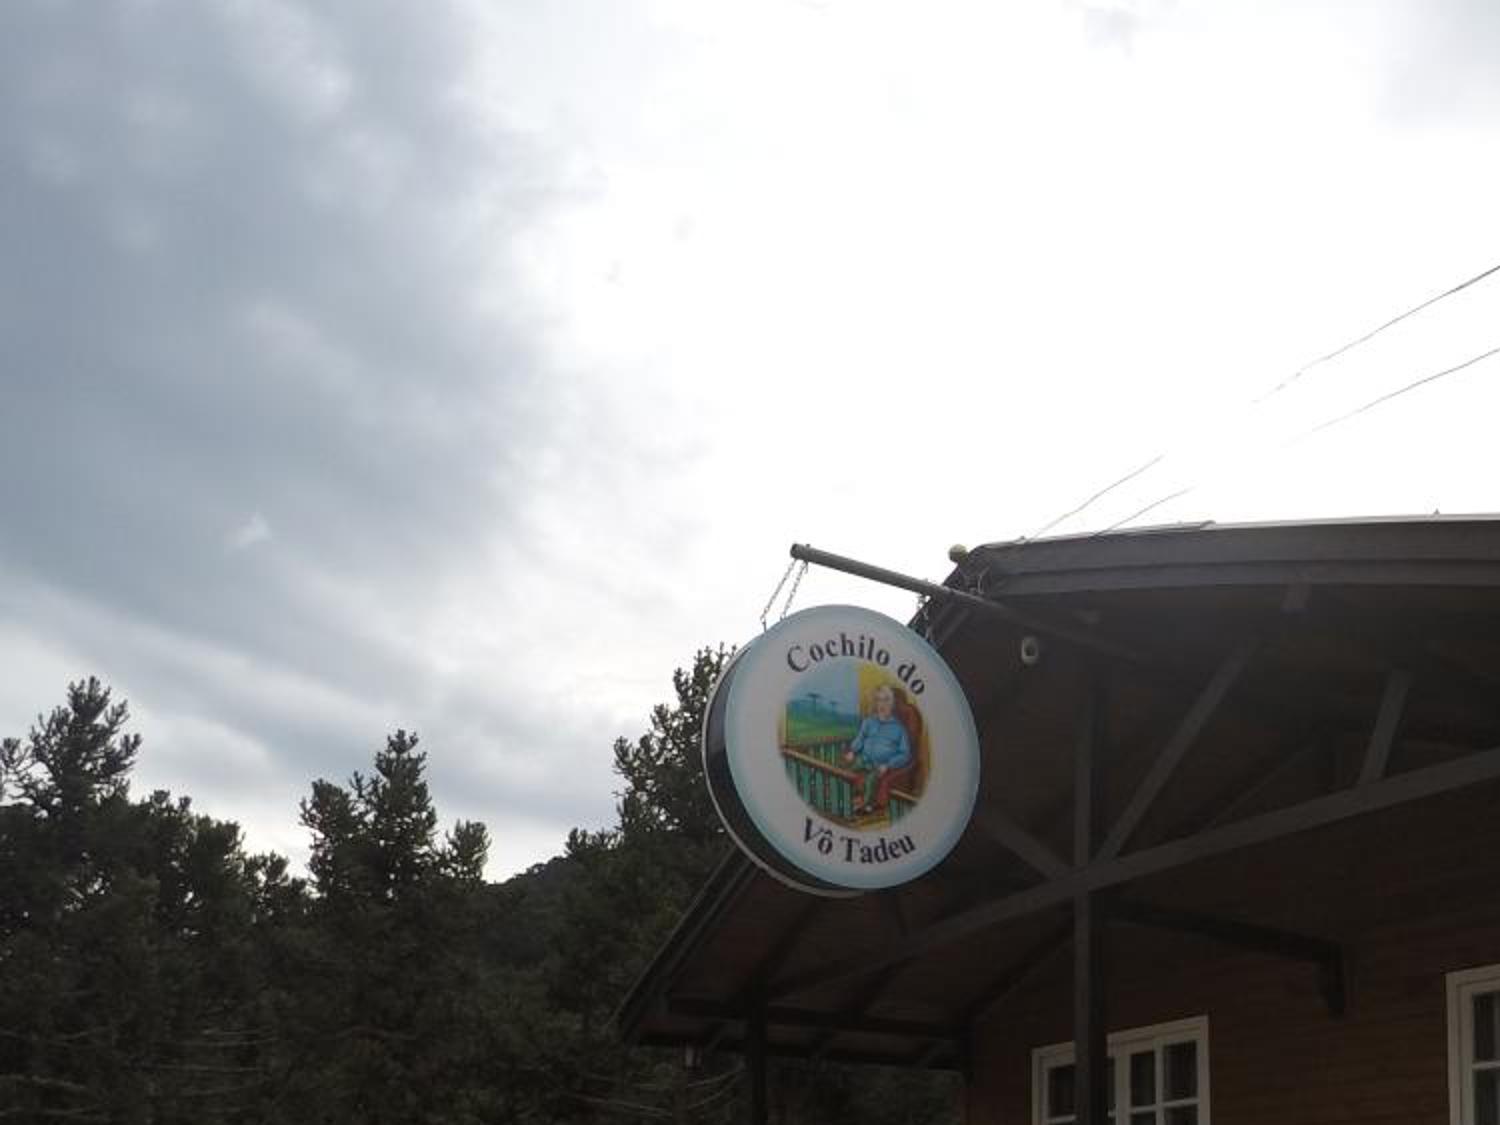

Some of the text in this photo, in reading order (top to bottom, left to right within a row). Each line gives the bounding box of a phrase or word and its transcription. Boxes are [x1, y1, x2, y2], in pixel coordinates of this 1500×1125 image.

[787, 633, 926, 696] Cochilo do
[801, 817, 916, 864] Vô Tadeu
